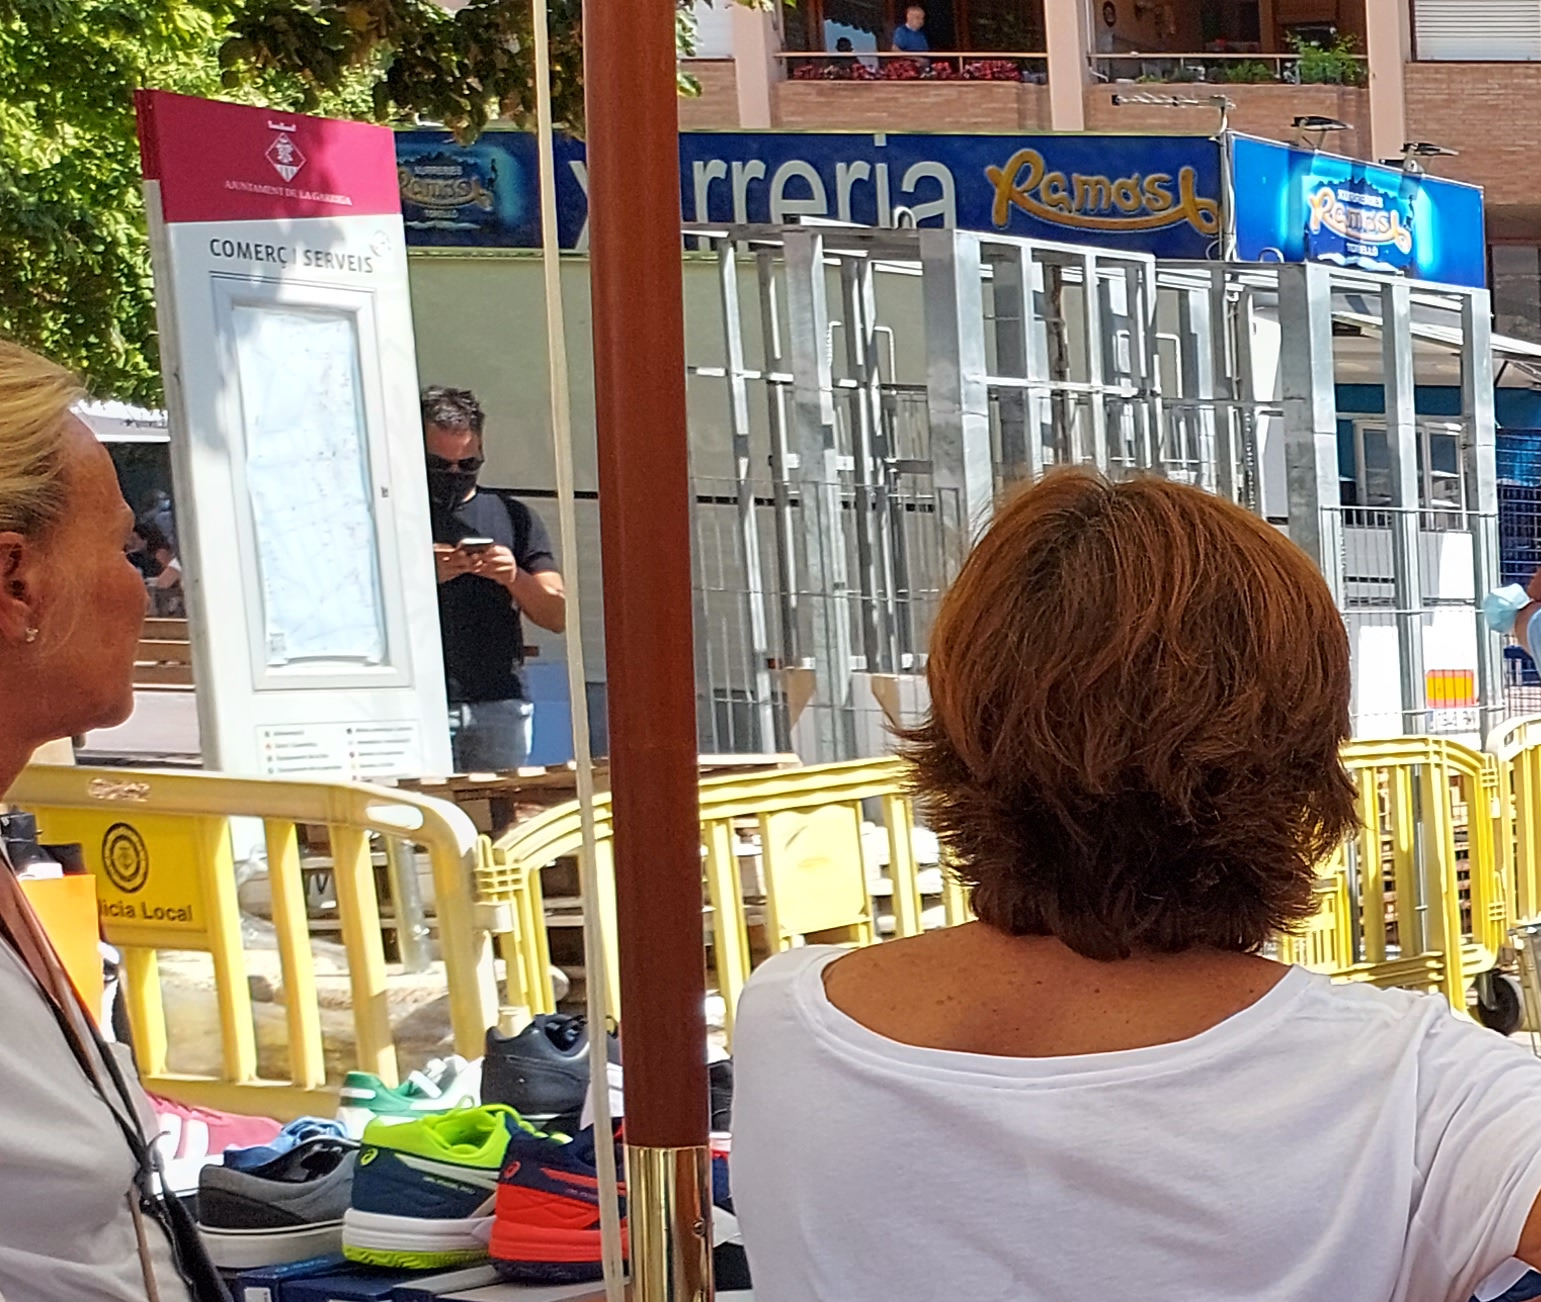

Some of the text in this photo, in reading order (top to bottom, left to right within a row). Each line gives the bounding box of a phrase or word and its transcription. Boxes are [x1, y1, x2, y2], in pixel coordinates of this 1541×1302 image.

[225, 180, 285, 196] AJUNTAMENT
[286, 187, 298, 198] DE
[300, 189, 311, 199] LA
[210, 238, 373, 273] COMERÇ I SERVEIS
[142, 901, 193, 922] Local
